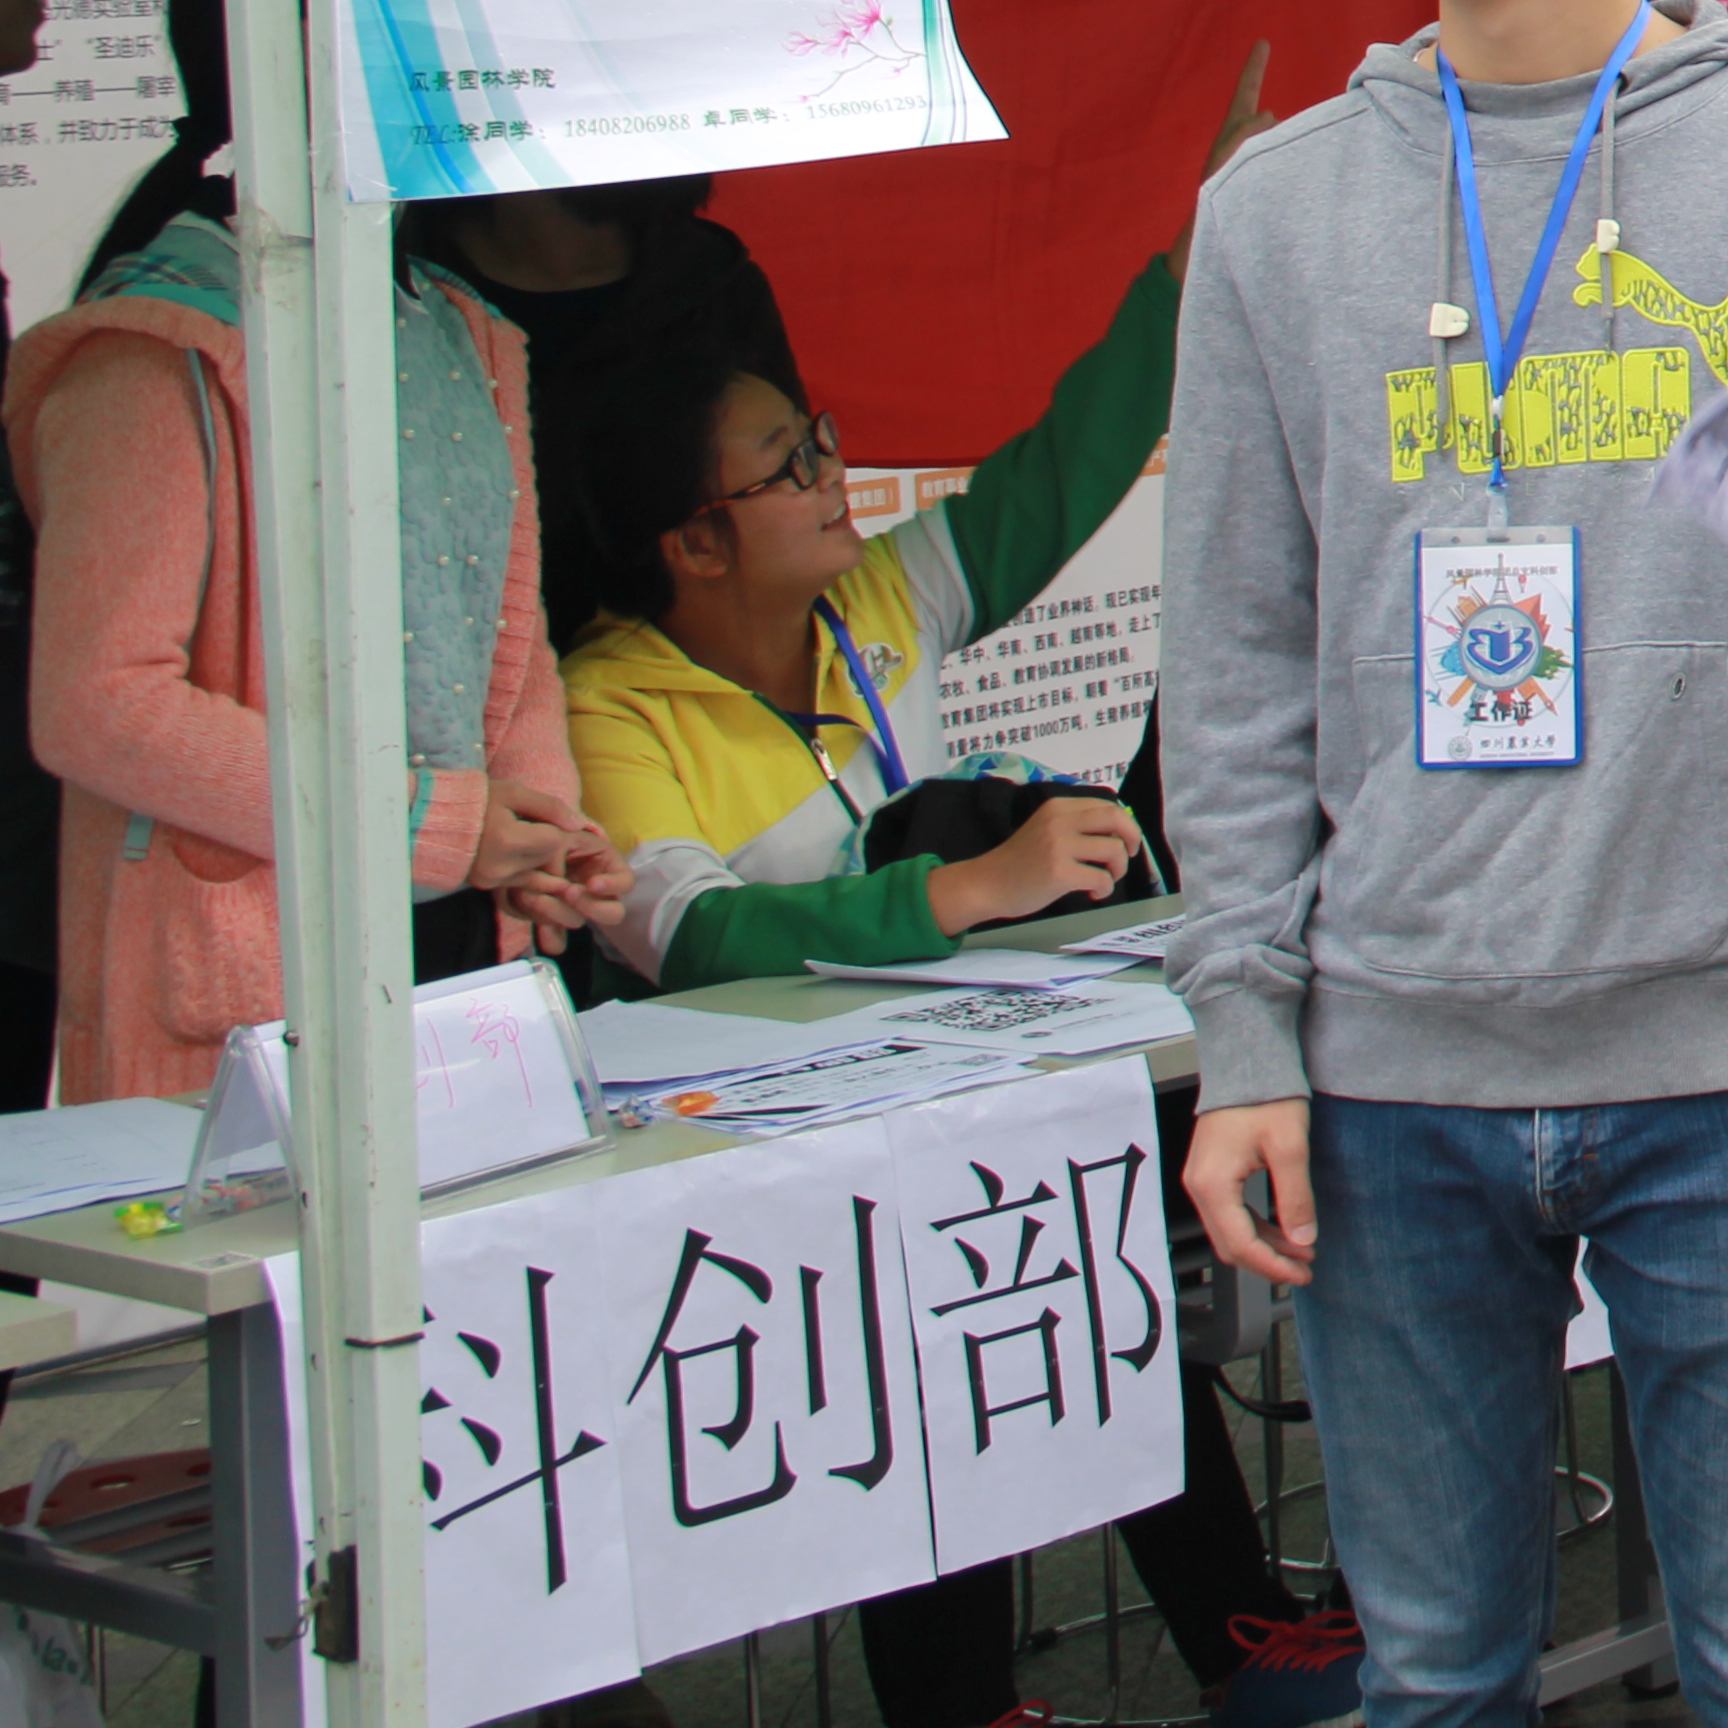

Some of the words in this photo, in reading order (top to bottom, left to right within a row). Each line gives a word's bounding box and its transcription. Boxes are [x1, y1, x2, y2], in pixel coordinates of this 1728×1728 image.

[409, 67, 557, 92] 风景园林学院
[564, 113, 691, 138] 18408206988
[1386, 346, 1692, 483] PUMA
[1470, 700, 1533, 722] 工作证
